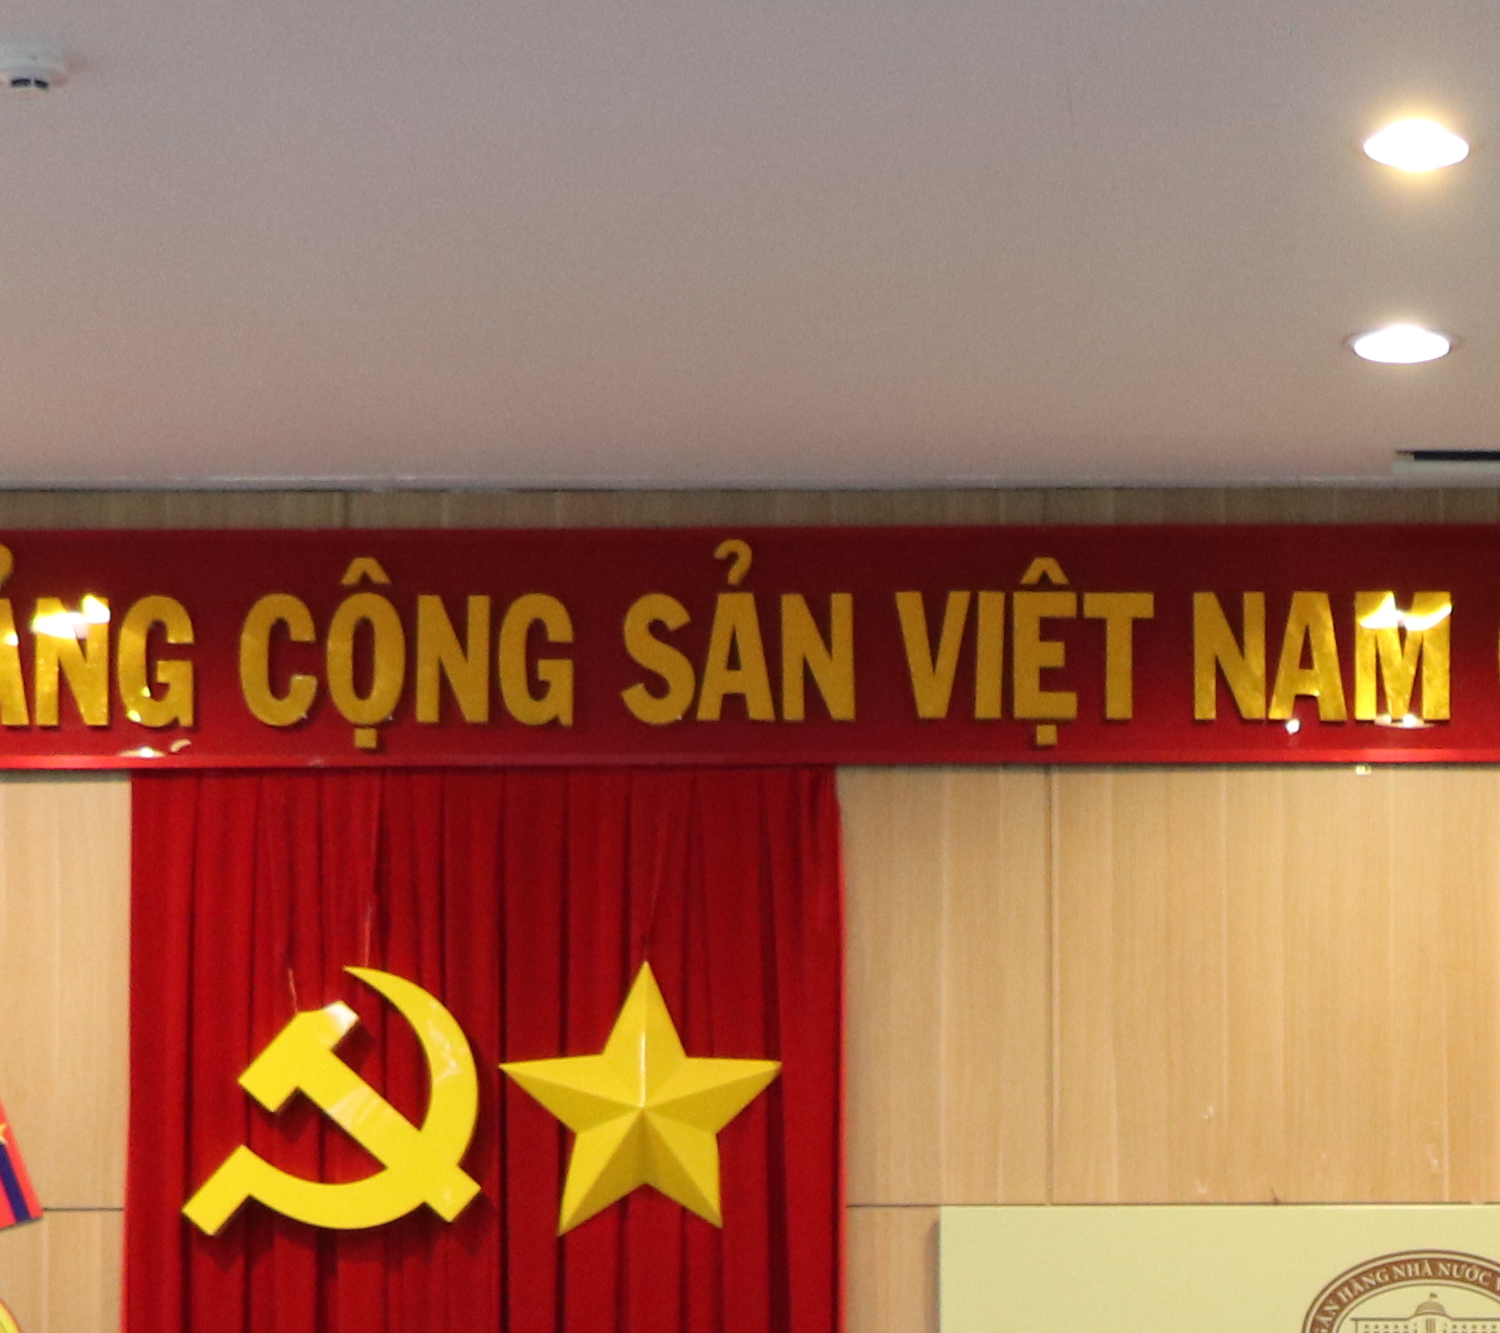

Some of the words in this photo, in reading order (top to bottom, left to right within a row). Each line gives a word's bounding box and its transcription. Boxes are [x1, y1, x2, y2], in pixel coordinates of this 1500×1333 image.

[241, 557, 573, 749] CỘNG
[623, 540, 854, 724] SẢN
[896, 557, 1153, 744] VIỆT
[1194, 590, 1452, 722] NAM
[1392, 1259, 1433, 1279] NHÀ
